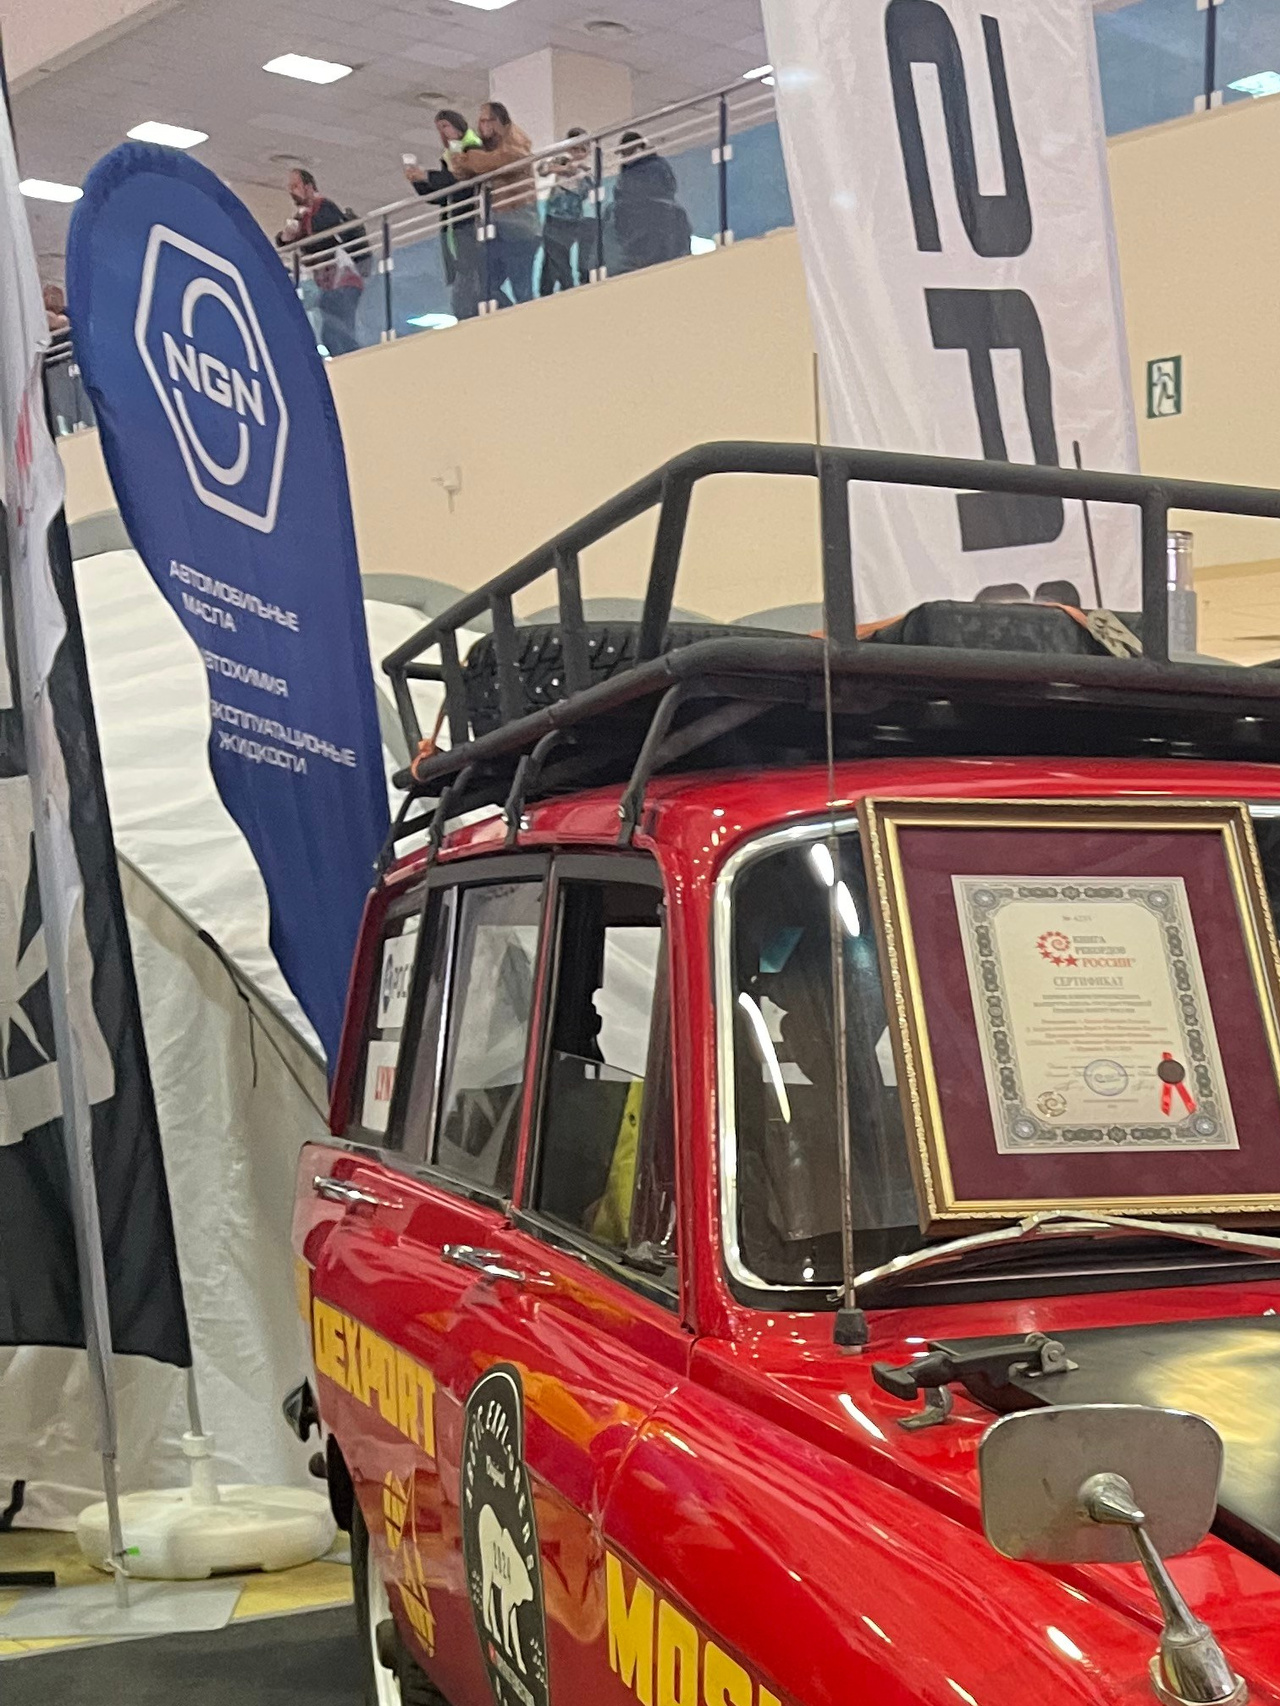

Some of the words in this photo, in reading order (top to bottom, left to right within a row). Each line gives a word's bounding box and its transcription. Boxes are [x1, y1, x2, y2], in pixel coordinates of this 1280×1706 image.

[162, 331, 266, 427] NGN
[169, 559, 300, 633] АВТОМОБИЛЬНЫЕ
[181, 591, 237, 633] МАСЛА
[202, 649, 290, 698] ВТОХИМИЯ
[218, 730, 308, 775] ЖИДКОСТИ
[1053, 976, 1124, 987] СЕРТИФИКАТ
[313, 1296, 436, 1459] OEXPORT
